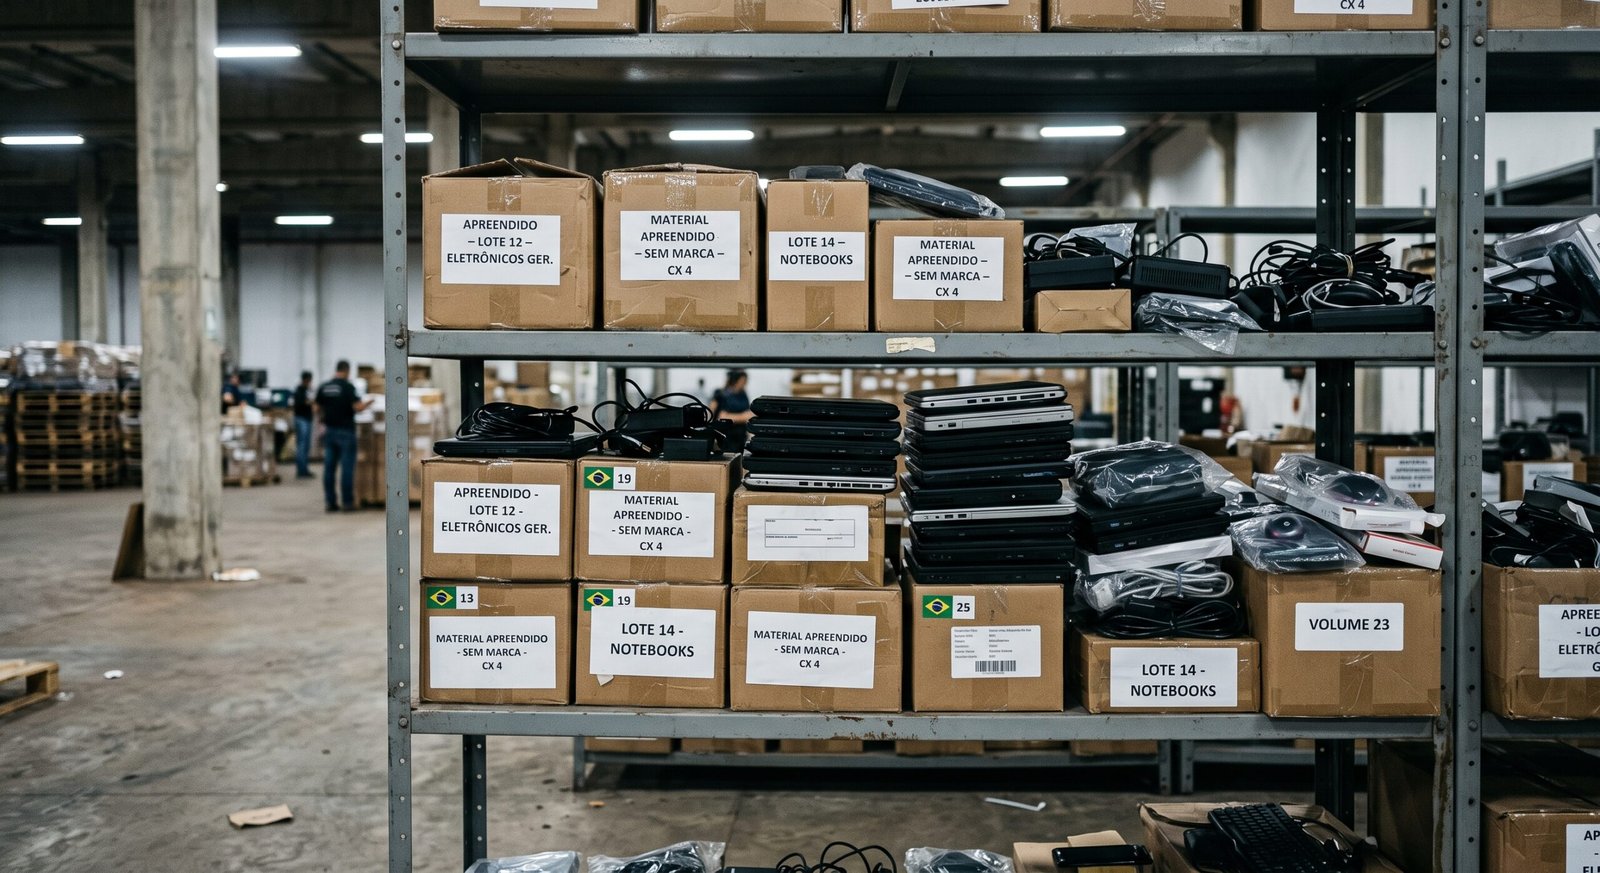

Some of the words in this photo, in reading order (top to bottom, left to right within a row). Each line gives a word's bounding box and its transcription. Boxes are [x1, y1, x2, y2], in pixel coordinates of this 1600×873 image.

[1340, 0, 1356, 10] CX
[1357, 0, 1366, 10] 4
[462, 219, 538, 231] APREENDIDO
[650, 214, 710, 225] MATERIAL
[477, 236, 506, 247] LOTE
[509, 237, 523, 248] 12
[640, 231, 716, 242] APREENDIDO
[788, 236, 818, 247] LOTE
[820, 236, 836, 247] 14
[920, 239, 976, 250] MATERIAL
[446, 250, 525, 265] ELETRÔNICOS
[526, 254, 554, 265] GER.
[644, 248, 669, 259] SEM
[672, 248, 715, 259] MARCA
[780, 254, 854, 265] NOTEBOOKS
[907, 255, 979, 266] APREENDIDO
[667, 265, 683, 276] CX
[684, 265, 693, 276] 4
[913, 270, 938, 281] SEM
[940, 271, 981, 282] MARCA
[935, 286, 950, 297] CX
[951, 287, 960, 297] 4
[617, 473, 632, 484] 19
[453, 487, 532, 500] APREENDIDO
[624, 495, 679, 506] MATERIAL
[469, 504, 499, 516] LOTE
[501, 505, 516, 517] 12
[613, 510, 683, 522] APREENDIDO
[441, 519, 522, 534] ELETRÔNICOS
[523, 523, 552, 535] GER.
[618, 525, 642, 536] SEM
[644, 526, 685, 537] MARCA
[639, 541, 654, 551] CX
[655, 541, 663, 552] 4
[460, 593, 474, 604] 13
[617, 595, 631, 606] 19
[956, 602, 971, 613] 25
[621, 622, 655, 636] LOTE
[658, 624, 676, 637] 14
[1308, 618, 1370, 631] VOLUME
[1373, 618, 1390, 631] 23
[436, 634, 485, 644] MATERIAL
[485, 634, 549, 644] APREENDIDO
[753, 630, 803, 641] MATERIAL
[804, 632, 868, 644] APREENDIDO
[462, 647, 484, 657] SEM
[485, 648, 522, 657] MARCA
[610, 642, 695, 658] NOTEBOOKS
[780, 644, 802, 655] SEM
[803, 645, 840, 656] MARCA
[481, 661, 495, 671] CX
[496, 661, 503, 671] 4
[799, 659, 812, 669] CX
[813, 659, 821, 669] 4
[1142, 663, 1176, 677] LOTE
[1179, 664, 1197, 677] 14
[1130, 684, 1217, 697] NOTEBOOKS
